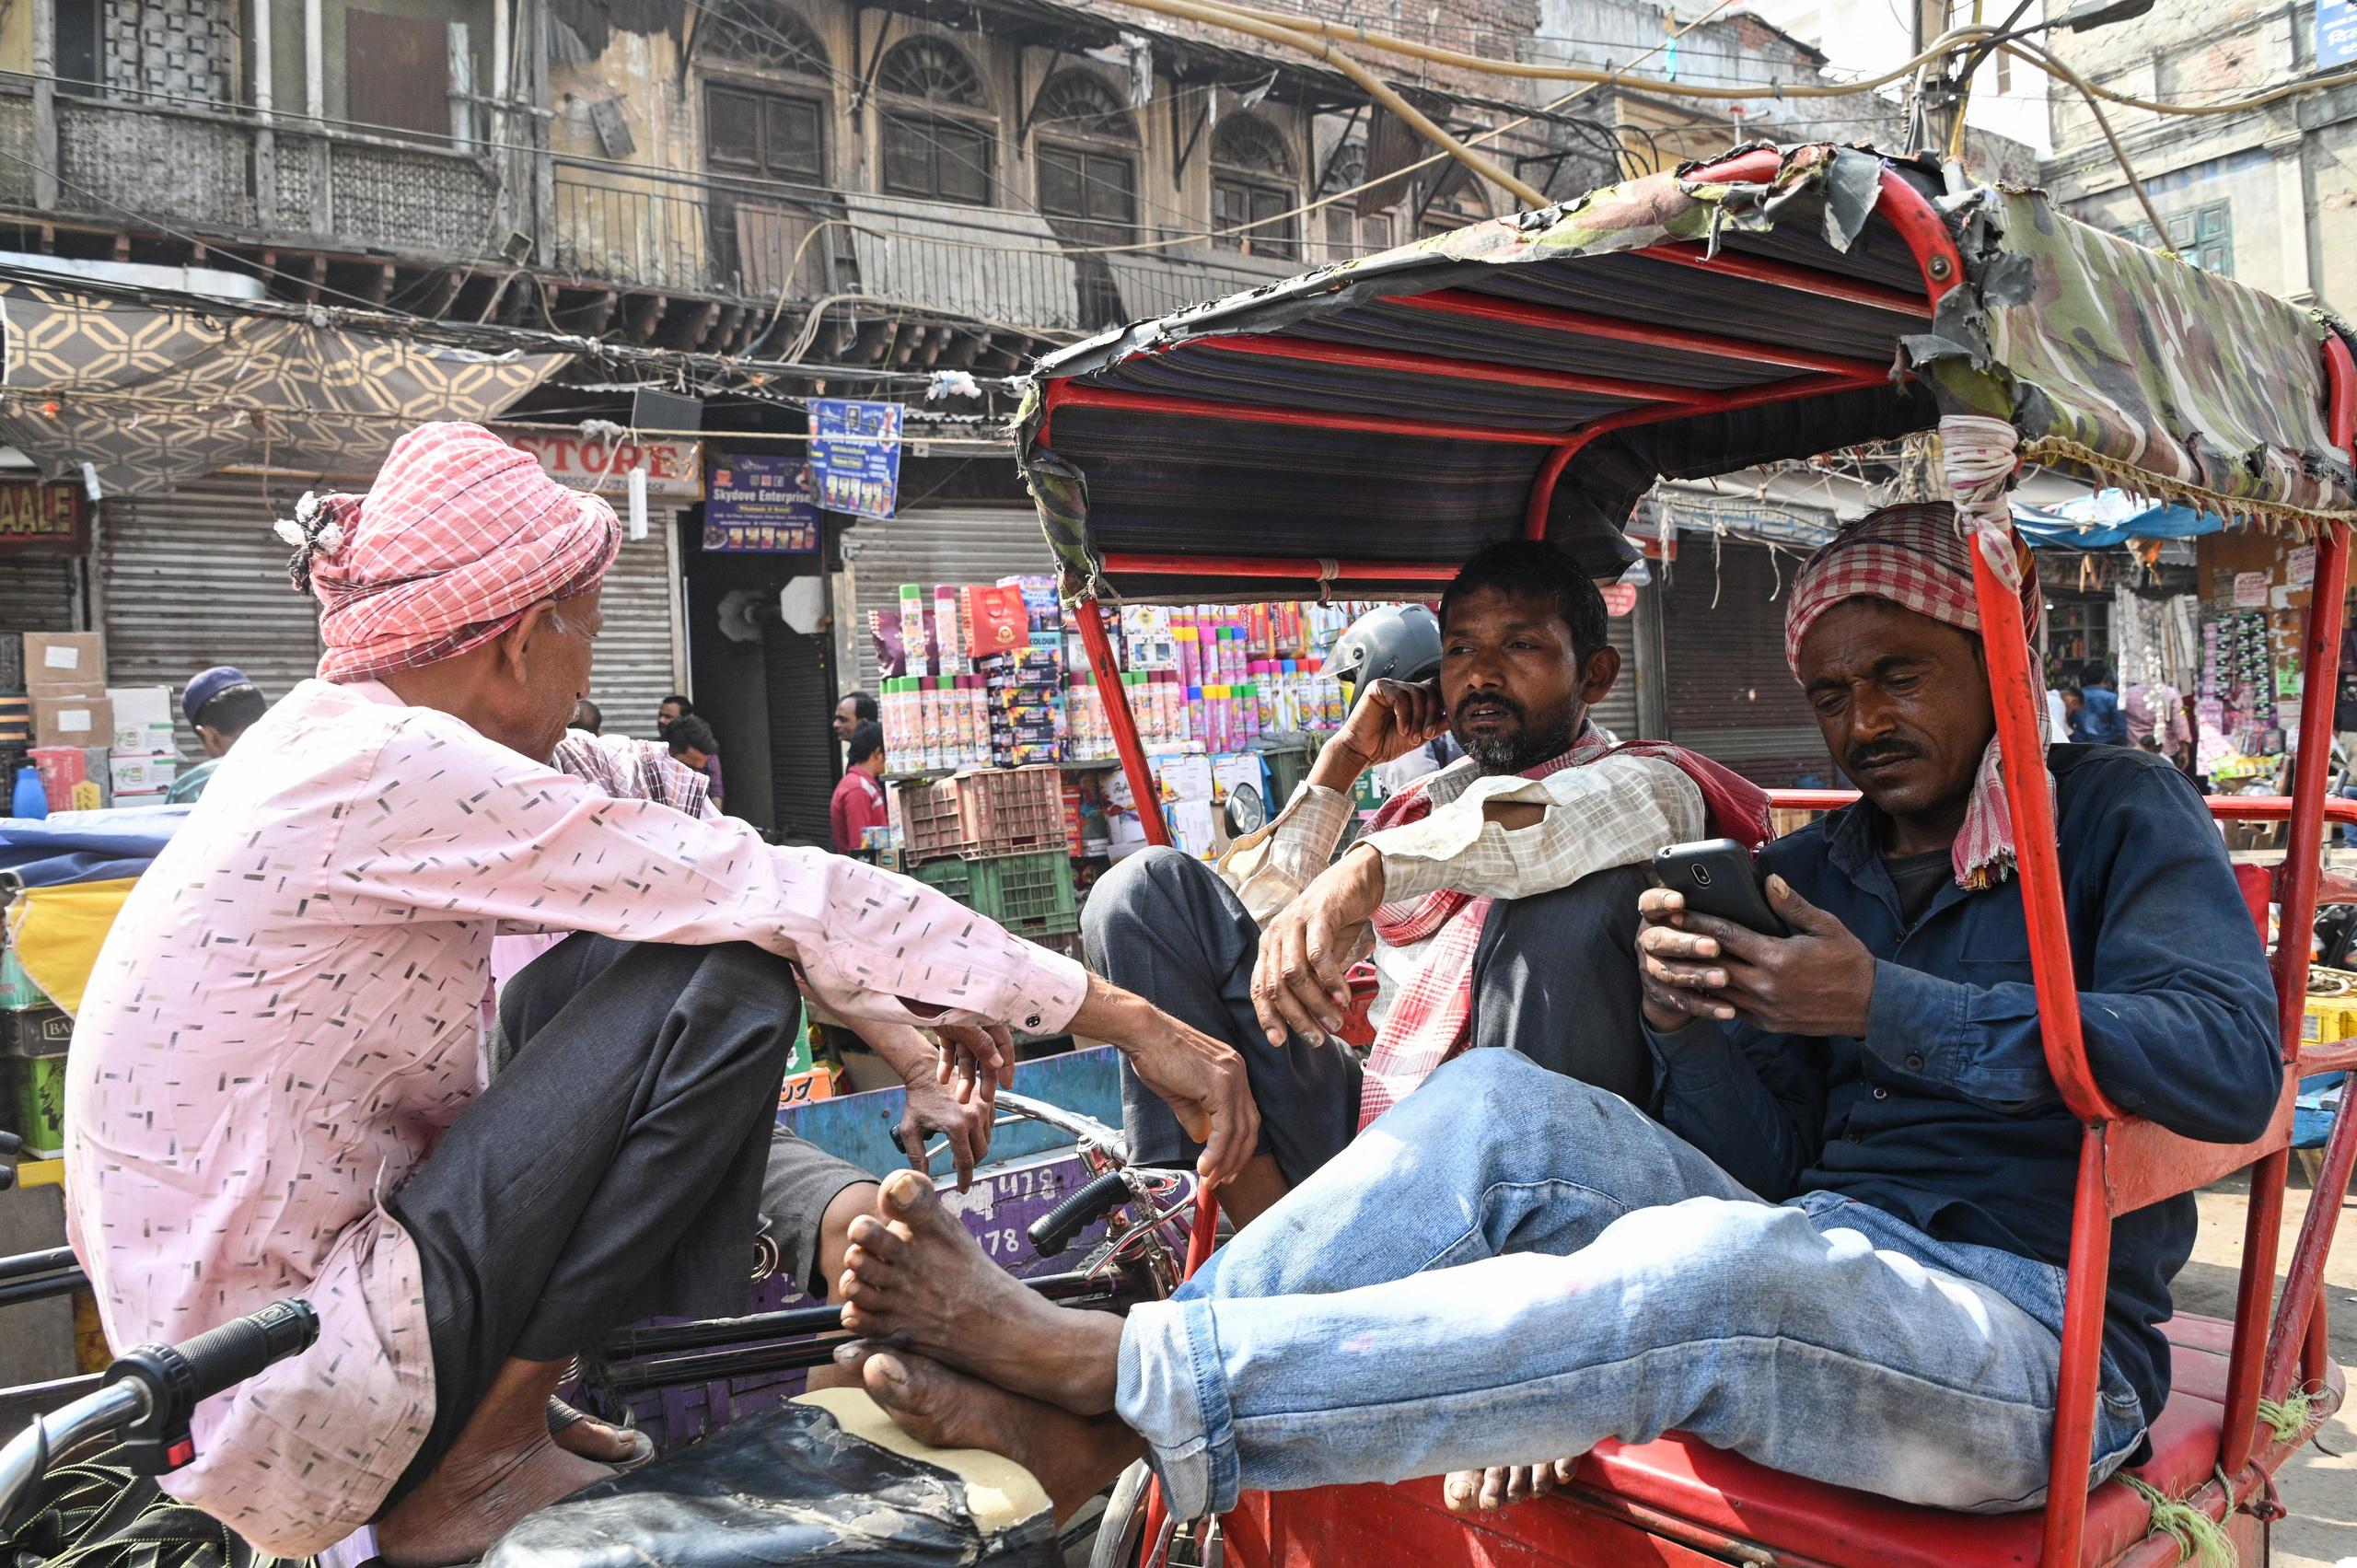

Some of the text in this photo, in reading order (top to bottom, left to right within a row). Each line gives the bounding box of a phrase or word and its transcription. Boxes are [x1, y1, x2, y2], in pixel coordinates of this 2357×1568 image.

[513, 436, 679, 478] STORE
[713, 488, 756, 503] Skydove
[976, 1227, 1020, 1256] 78
